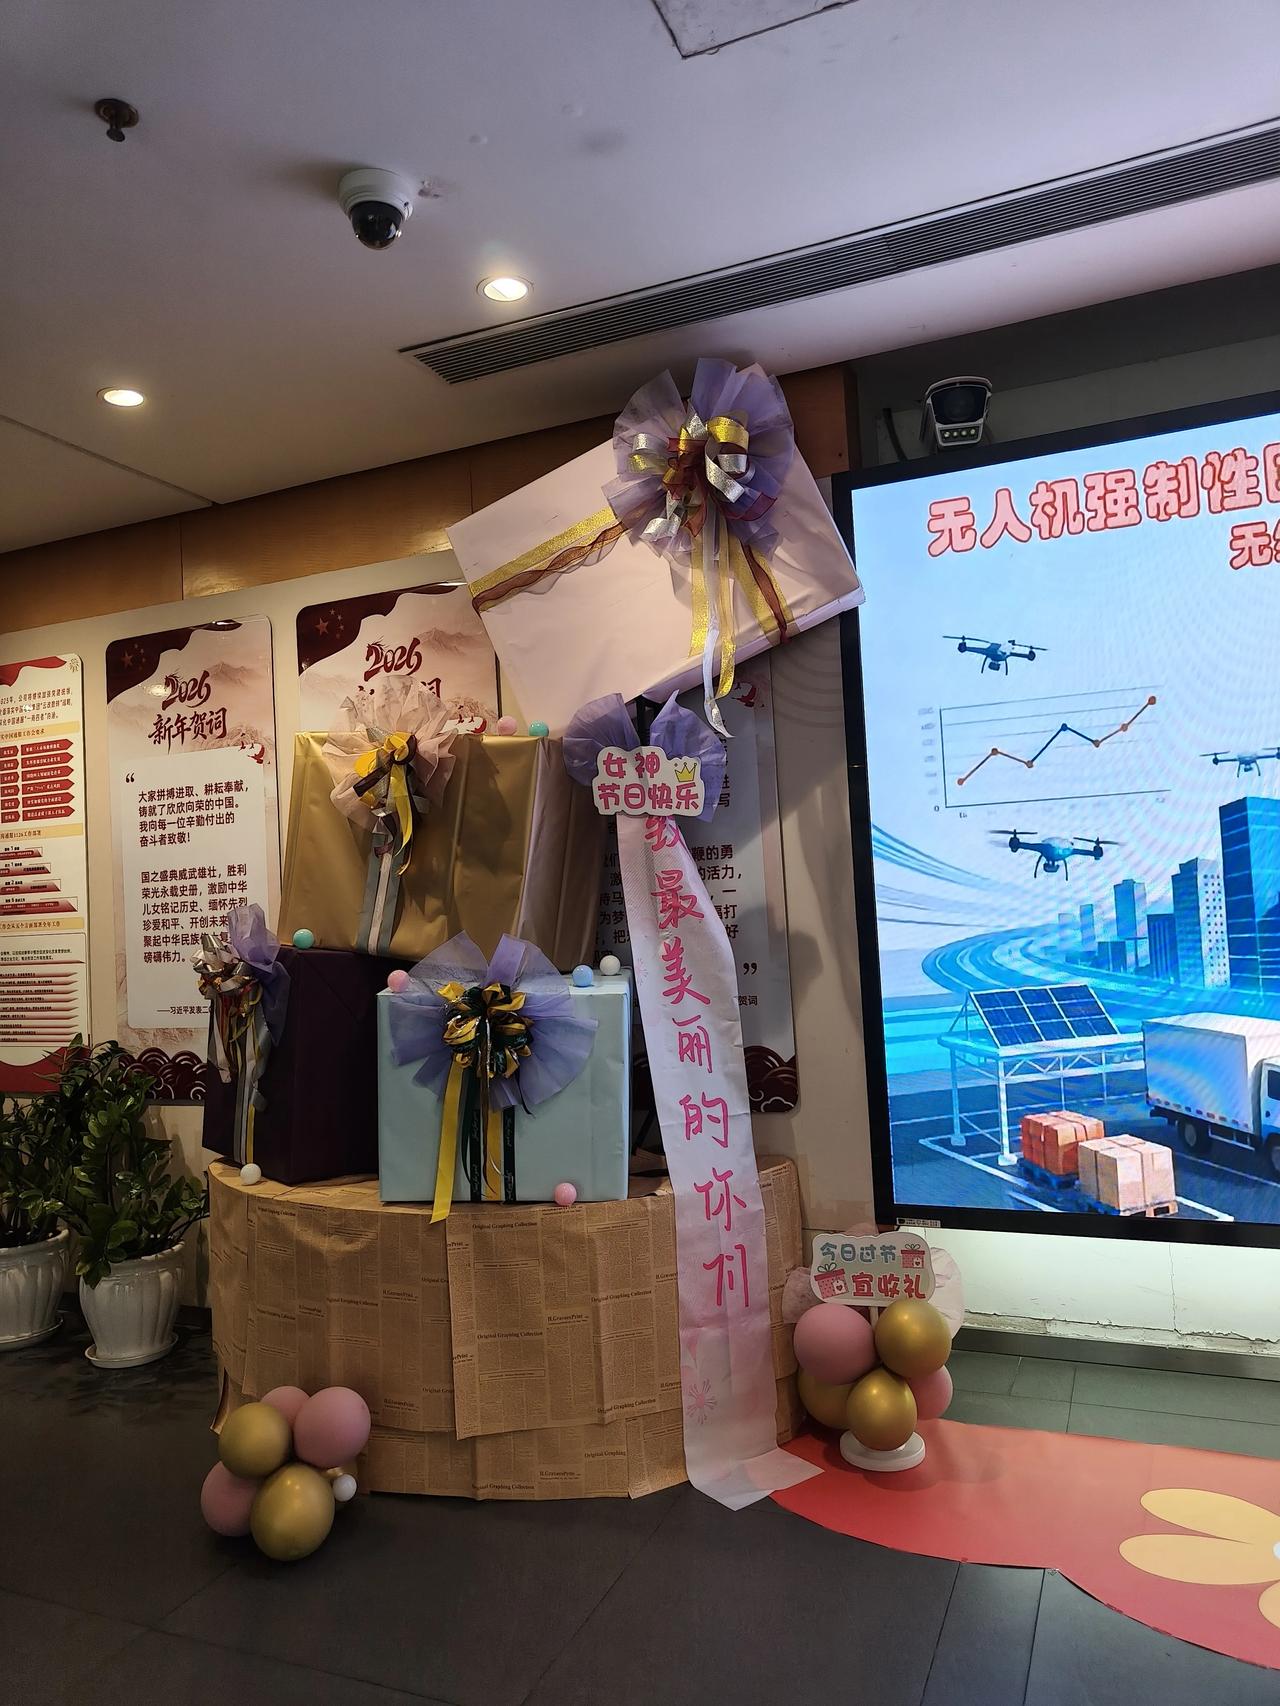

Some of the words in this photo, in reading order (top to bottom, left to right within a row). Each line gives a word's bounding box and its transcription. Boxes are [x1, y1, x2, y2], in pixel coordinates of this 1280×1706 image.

[363, 637, 422, 682] 2026
[161, 670, 211, 711] 2026
[148, 707, 227, 755] 新年贺词
[602, 751, 661, 779] 女神
[138, 779, 249, 803] 大家拼搏进取、耕耘奉献，
[597, 782, 699, 810] 节日快乐
[138, 796, 239, 818] 铸就了欣欣向荣的中国。
[139, 811, 235, 834] 我向每一位辛勤付出的
[139, 831, 190, 848] 奋斗者致敬！
[141, 863, 247, 884] 国之盛典威武雄壮，胜利
[141, 880, 248, 900] 荣光永载史册，激励中华
[143, 950, 186, 964] 磅礴伟力。
[157, 1006, 211, 1015] ——习近平发表二
[820, 1241, 897, 1264] 今日过节
[851, 1271, 926, 1300] 宜收礼
